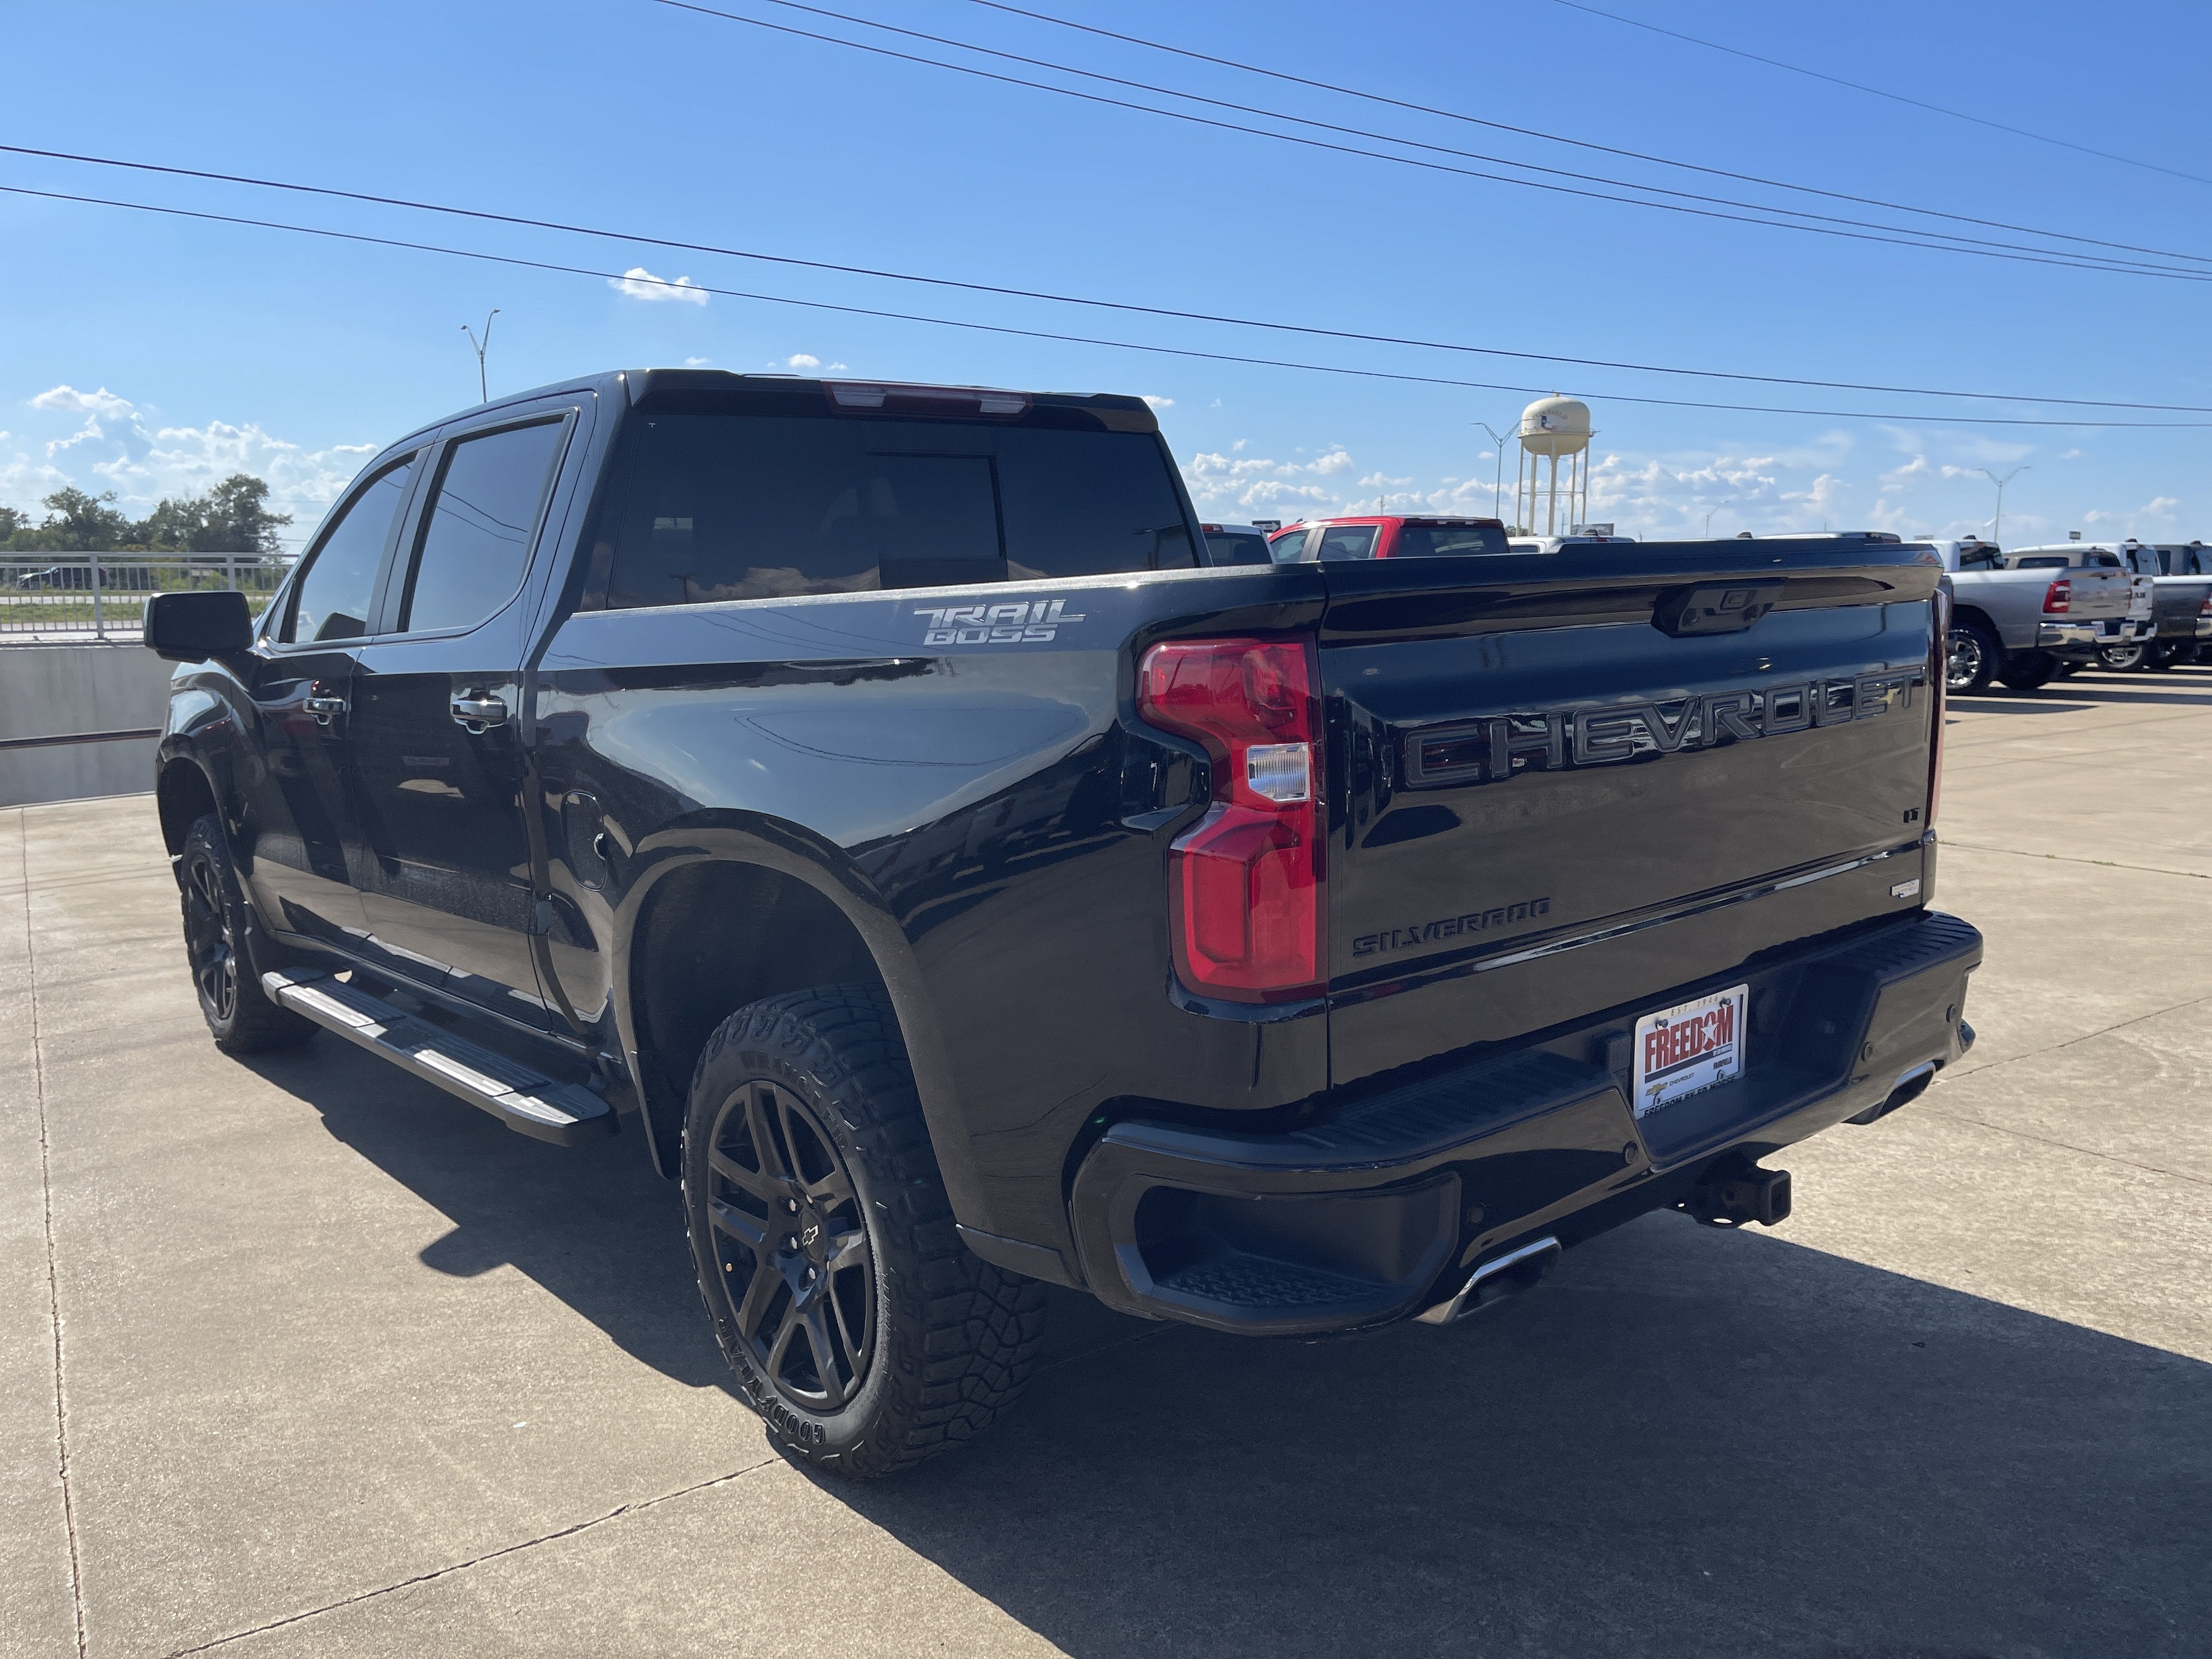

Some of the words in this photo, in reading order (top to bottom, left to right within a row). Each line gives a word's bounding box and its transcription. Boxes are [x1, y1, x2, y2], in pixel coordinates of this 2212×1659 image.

[914, 599, 1086, 629] TRAIL
[923, 624, 1059, 646] BOSS
[1406, 663, 1927, 788] CHEVROLET
[1353, 897, 1551, 957] SILVERADO
[1645, 1005, 1734, 1074] FREEDOM
[1669, 1073, 1695, 1086] CHEVROLET
[1644, 1098, 1683, 1118] FREEDOM
[718, 1317, 826, 1446] GOODYEAR
